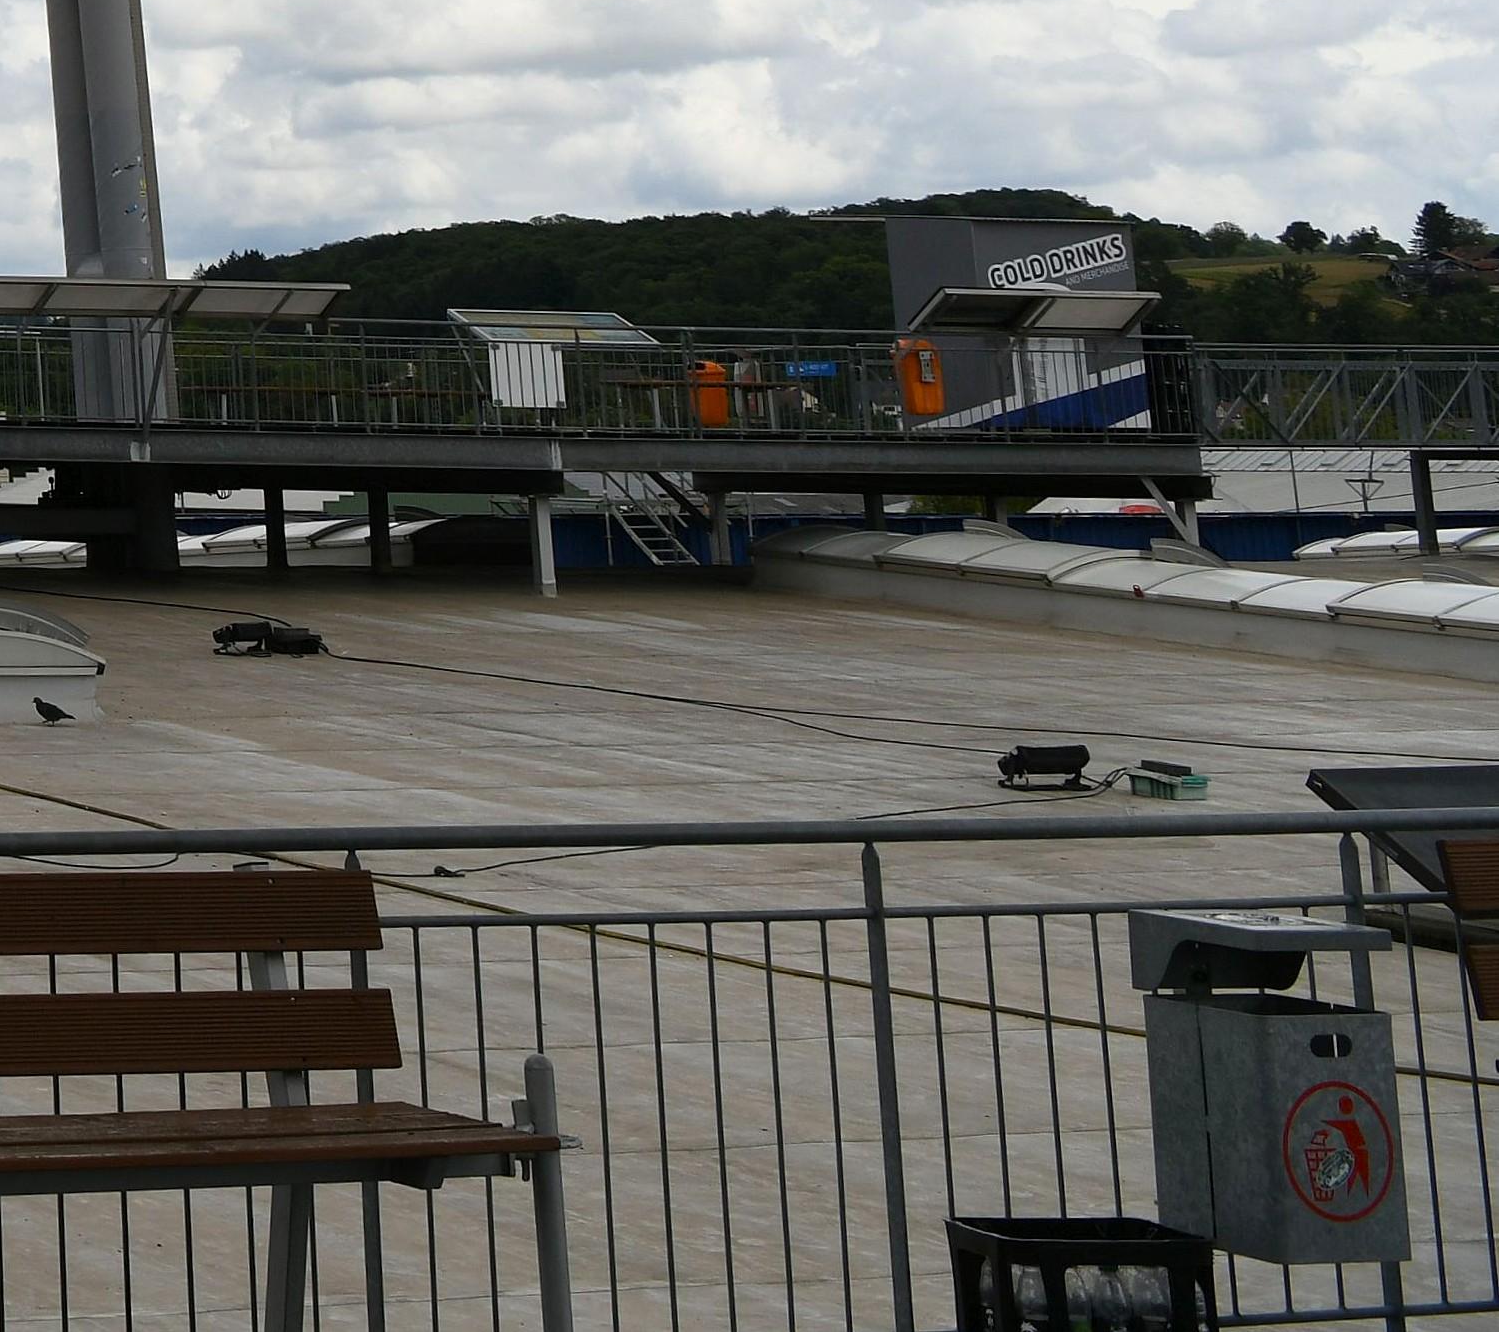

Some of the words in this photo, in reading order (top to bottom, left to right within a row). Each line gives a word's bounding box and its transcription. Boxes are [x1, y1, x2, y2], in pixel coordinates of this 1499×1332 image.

[990, 257, 1045, 288] COLD
[1050, 236, 1124, 275] DRINKS
[1065, 274, 1081, 286] AND
[1081, 262, 1129, 281] MERCHANDISE
